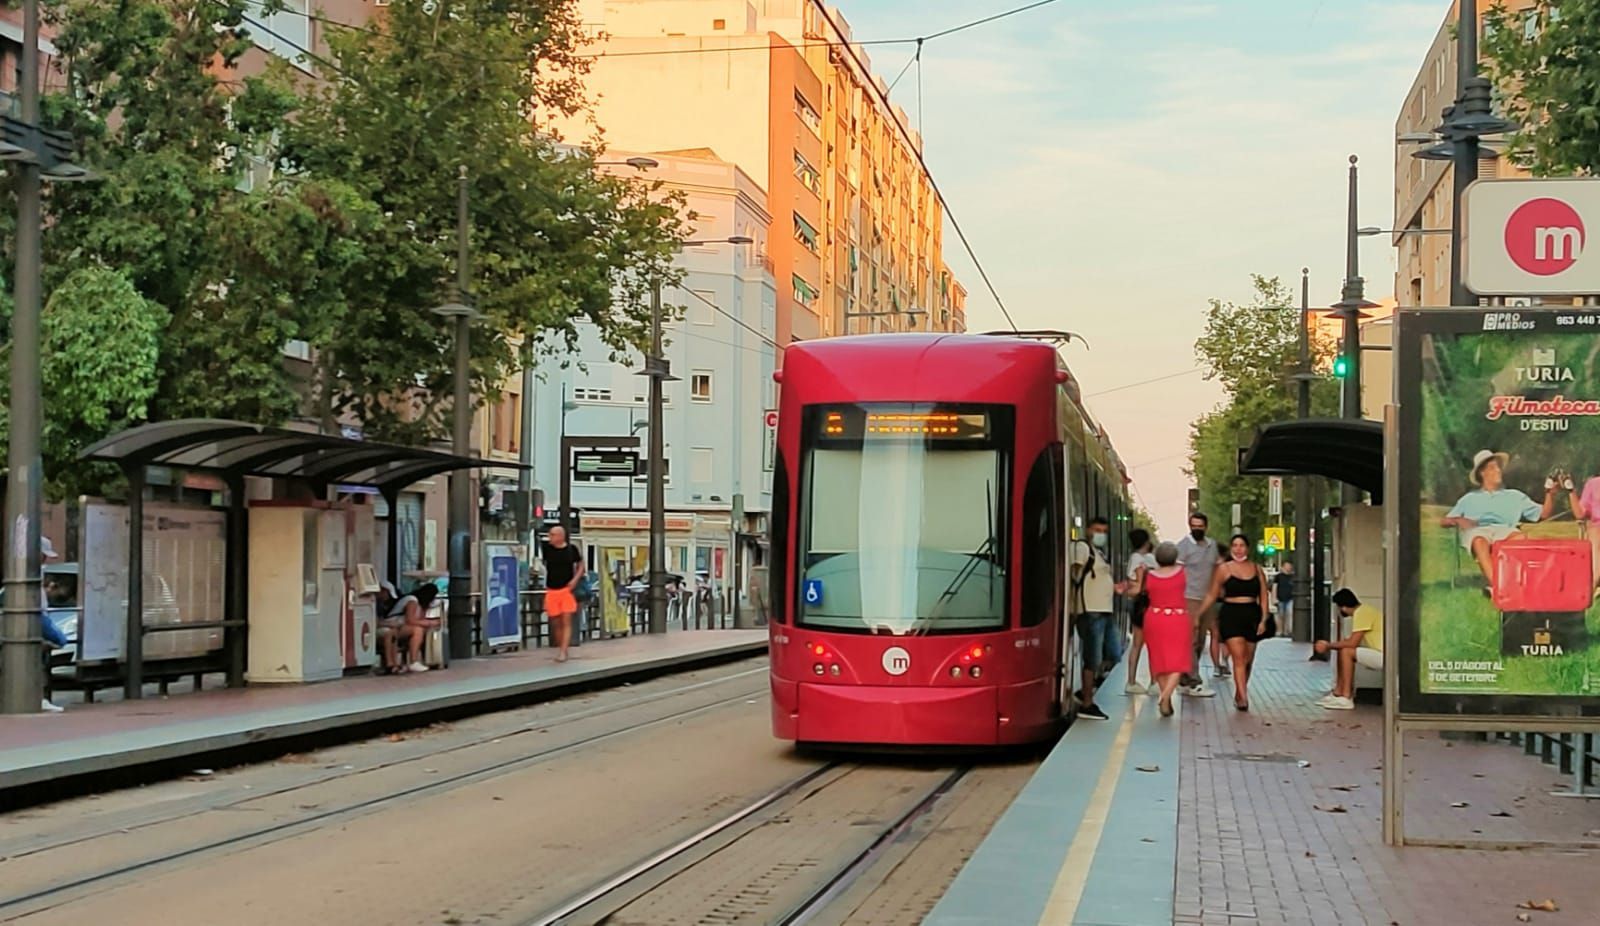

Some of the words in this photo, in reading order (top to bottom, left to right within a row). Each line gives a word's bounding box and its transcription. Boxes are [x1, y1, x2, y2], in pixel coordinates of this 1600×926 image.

[1534, 225, 1582, 261] m
[1498, 312, 1521, 321] PRO
[1497, 320, 1536, 330] MEDIOS
[1515, 367, 1574, 381] TURIA
[1485, 395, 1600, 420] Filmoteca
[1520, 418, 1569, 431] D'ESTIU
[1521, 644, 1563, 656] TURIA
[893, 657, 909, 669] m
